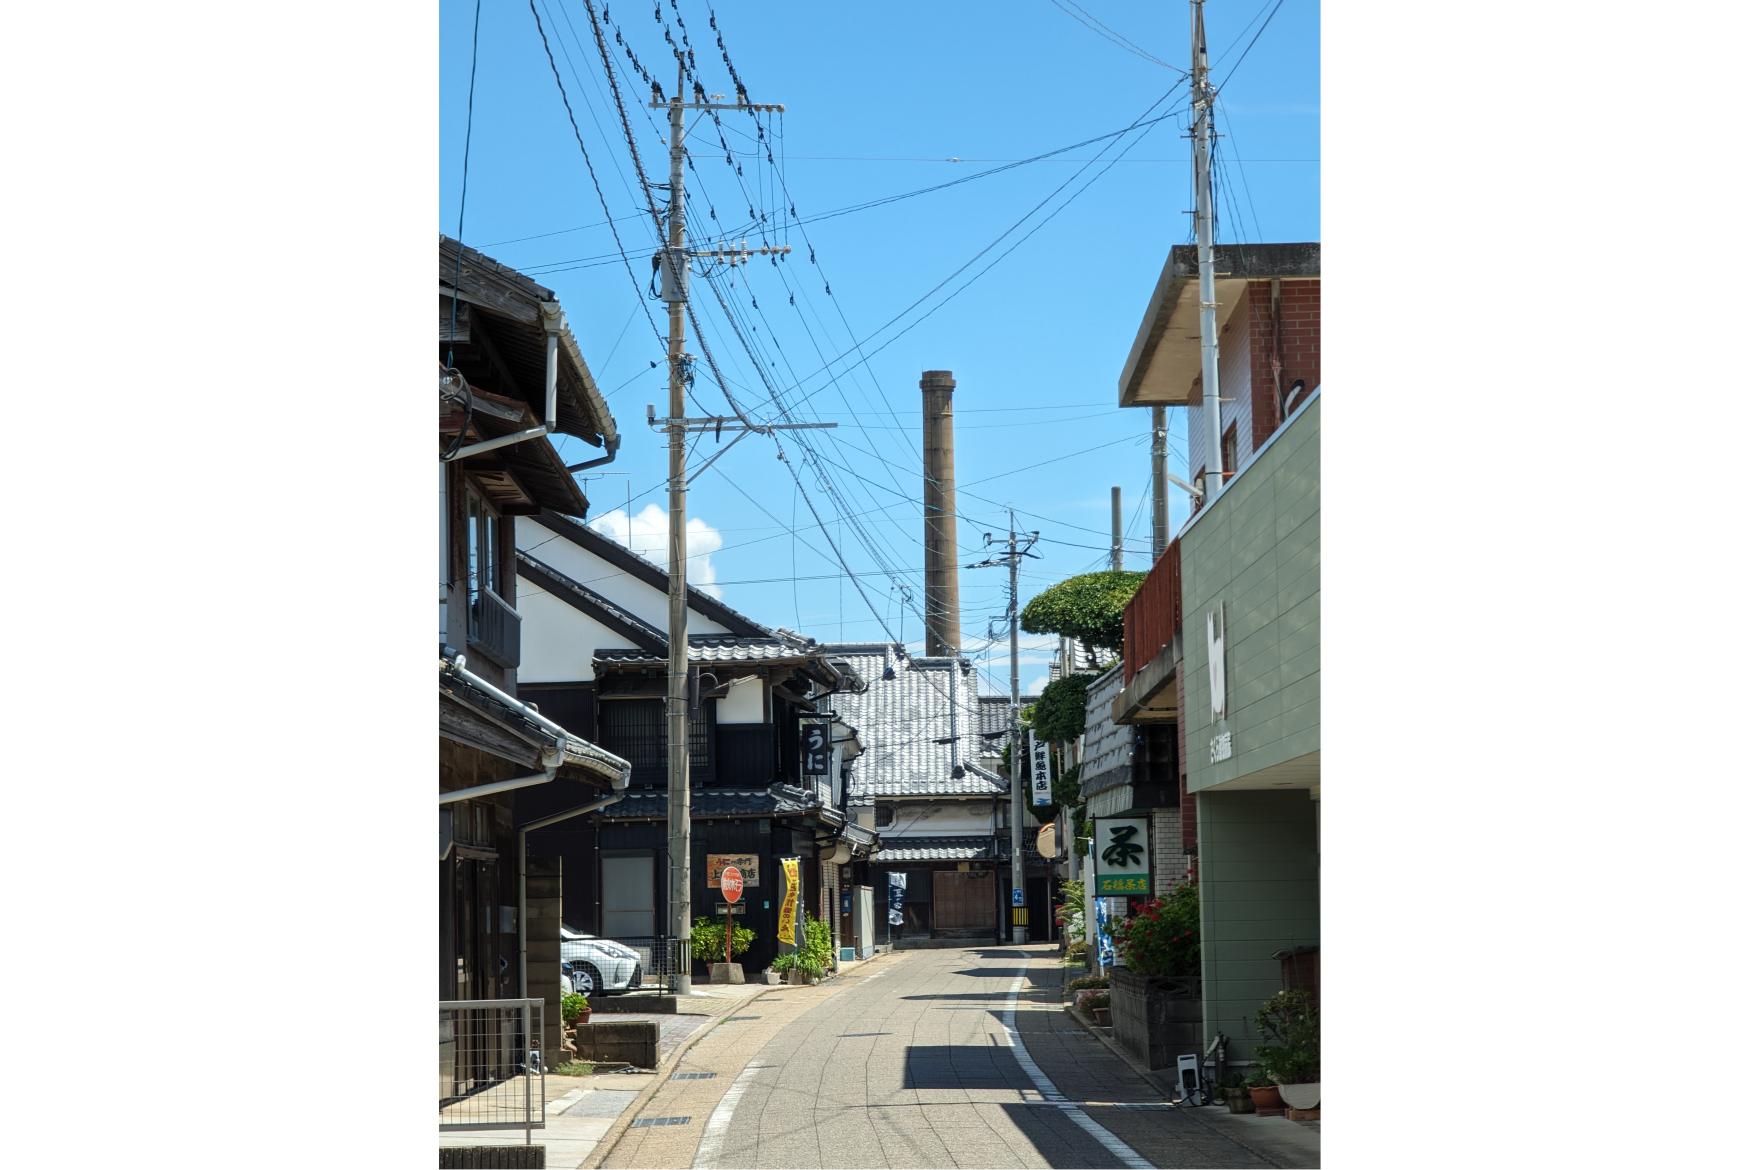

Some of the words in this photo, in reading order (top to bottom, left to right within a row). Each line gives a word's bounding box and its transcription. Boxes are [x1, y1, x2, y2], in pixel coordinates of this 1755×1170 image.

[808, 729, 824, 770] うに
[1033, 733, 1048, 791] 戸鮮魚本店
[1101, 825, 1144, 867] 茶
